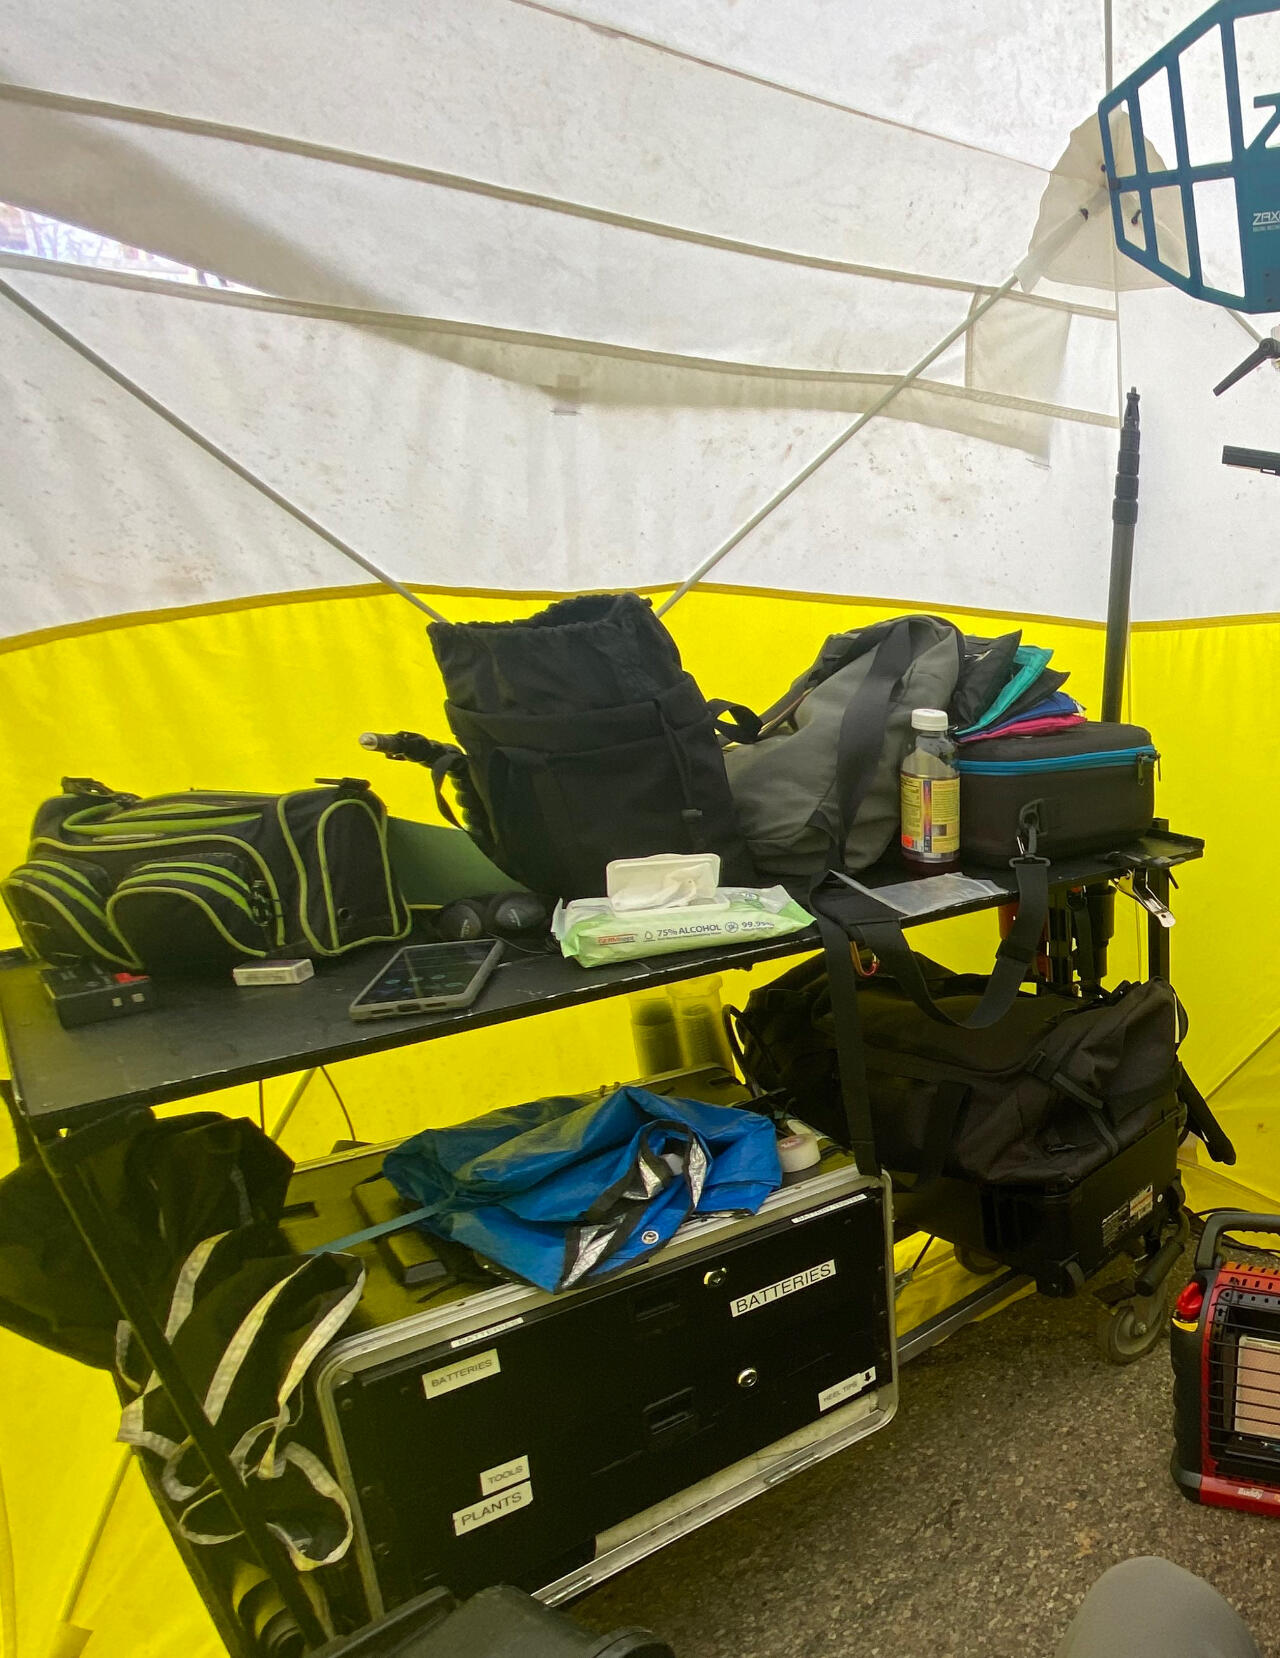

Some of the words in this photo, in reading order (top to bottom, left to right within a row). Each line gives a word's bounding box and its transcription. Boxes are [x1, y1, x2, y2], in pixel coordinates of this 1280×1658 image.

[657, 928, 677, 937] 75%
[678, 924, 721, 935] ALCOHOL
[736, 1264, 831, 1314] BATTERIES
[431, 1359, 493, 1388] BATTERIES
[488, 1465, 523, 1485] TOOLS
[461, 1491, 522, 1526] PLANTS
